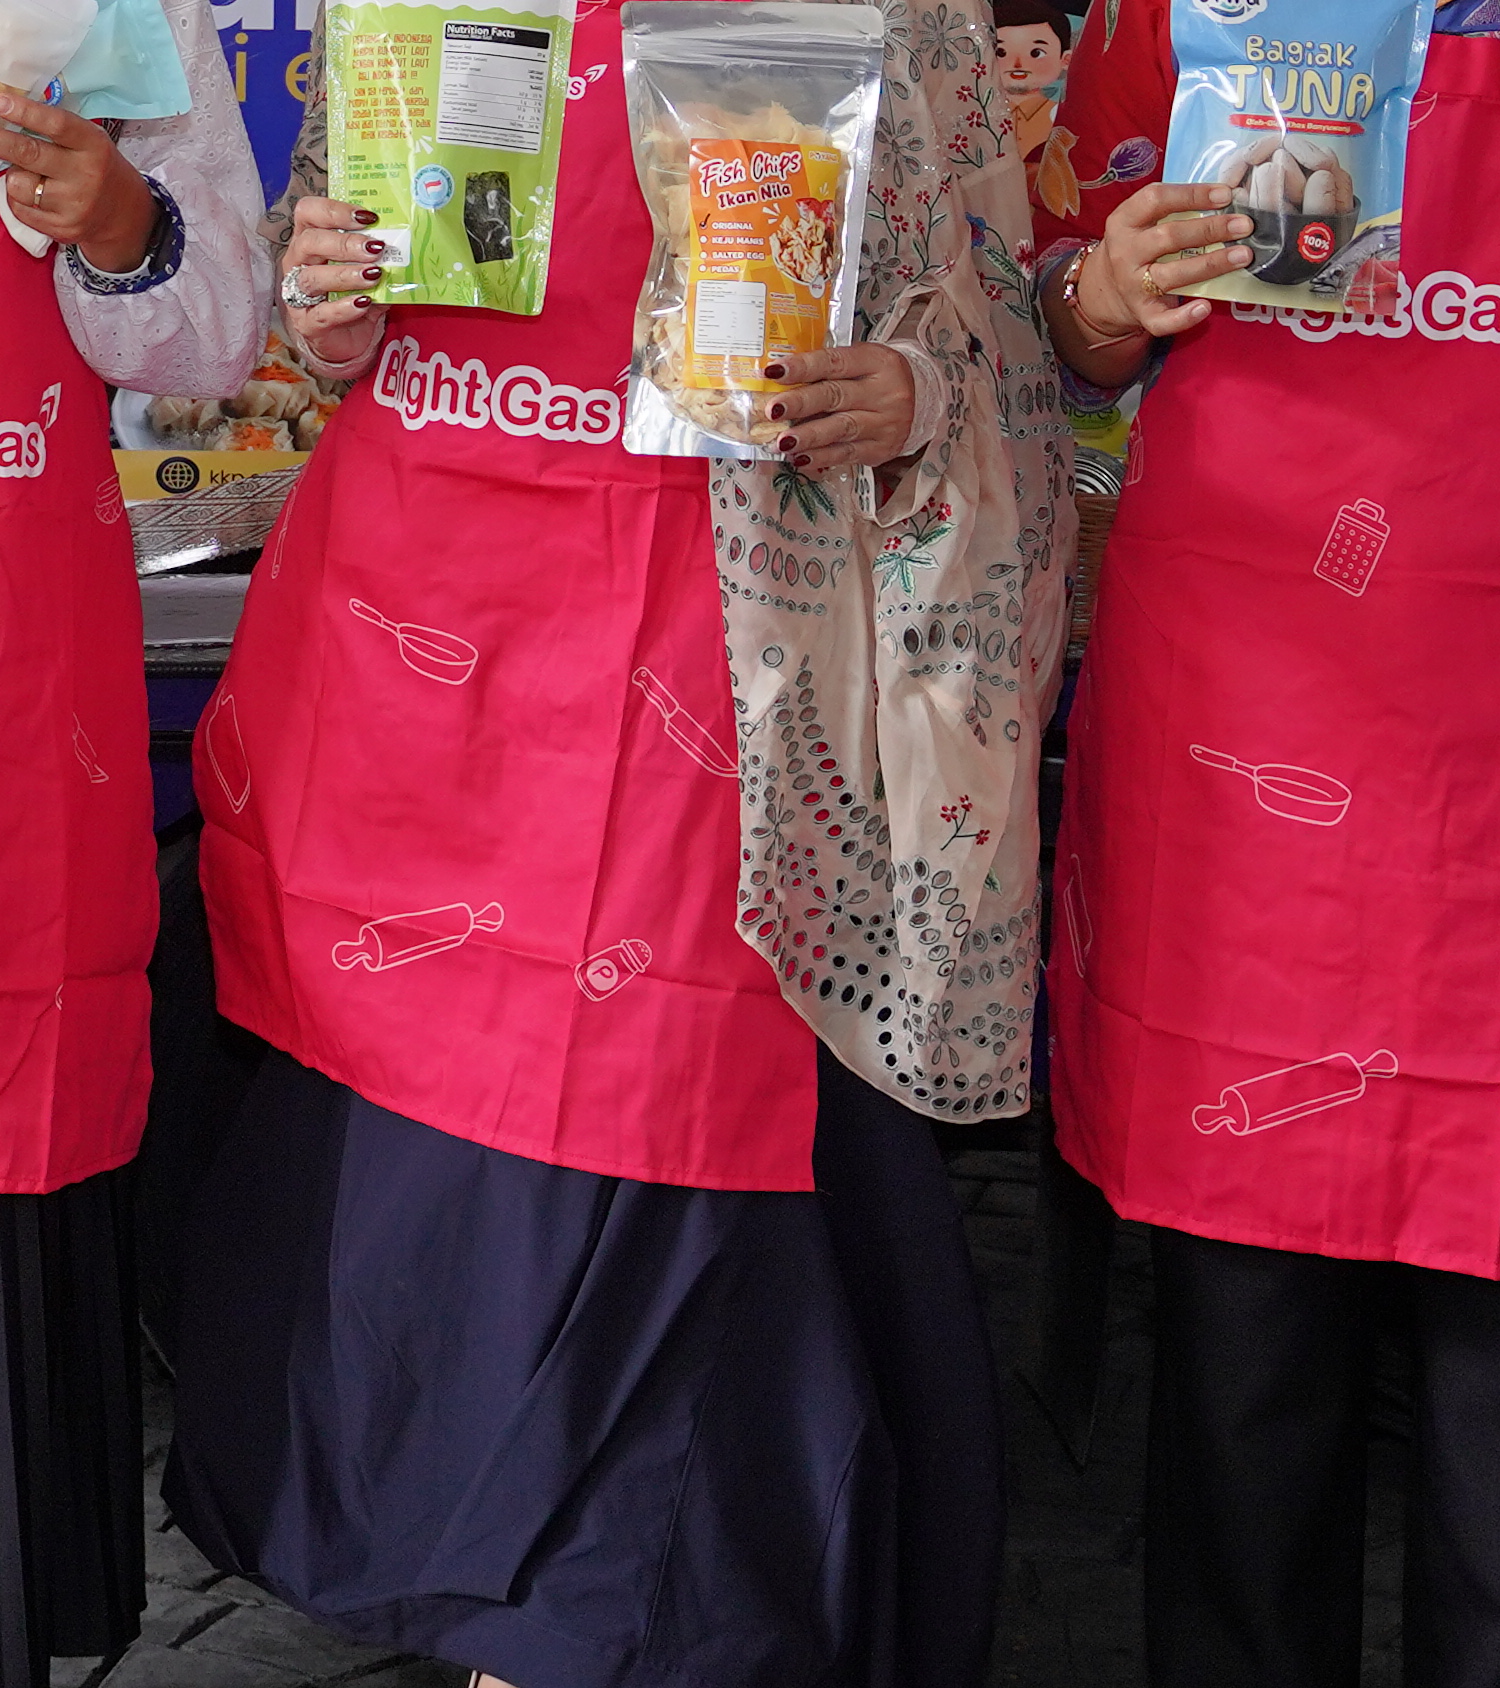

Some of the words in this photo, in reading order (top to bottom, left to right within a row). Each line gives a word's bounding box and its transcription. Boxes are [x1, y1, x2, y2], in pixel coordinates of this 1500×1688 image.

[446, 24, 490, 37] Nutrition
[491, 27, 516, 40] Facts
[411, 45, 430, 56] LAUT
[1245, 34, 1356, 68] Bagiak
[411, 58, 430, 68] LAUT
[1226, 64, 1375, 120] TUNA
[701, 160, 746, 195] Fish
[752, 151, 801, 182] Chips
[717, 190, 758, 209] Ikan
[760, 182, 792, 202] Nila
[711, 221, 753, 230] ORIGINAL
[711, 235, 734, 244] KEJU
[736, 236, 764, 245] MANIS
[1303, 235, 1330, 251] 100%
[712, 251, 745, 260] SALTED
[746, 251, 765, 260] EGG
[711, 265, 740, 273] PEDAS
[499, 375, 612, 434] Gas
